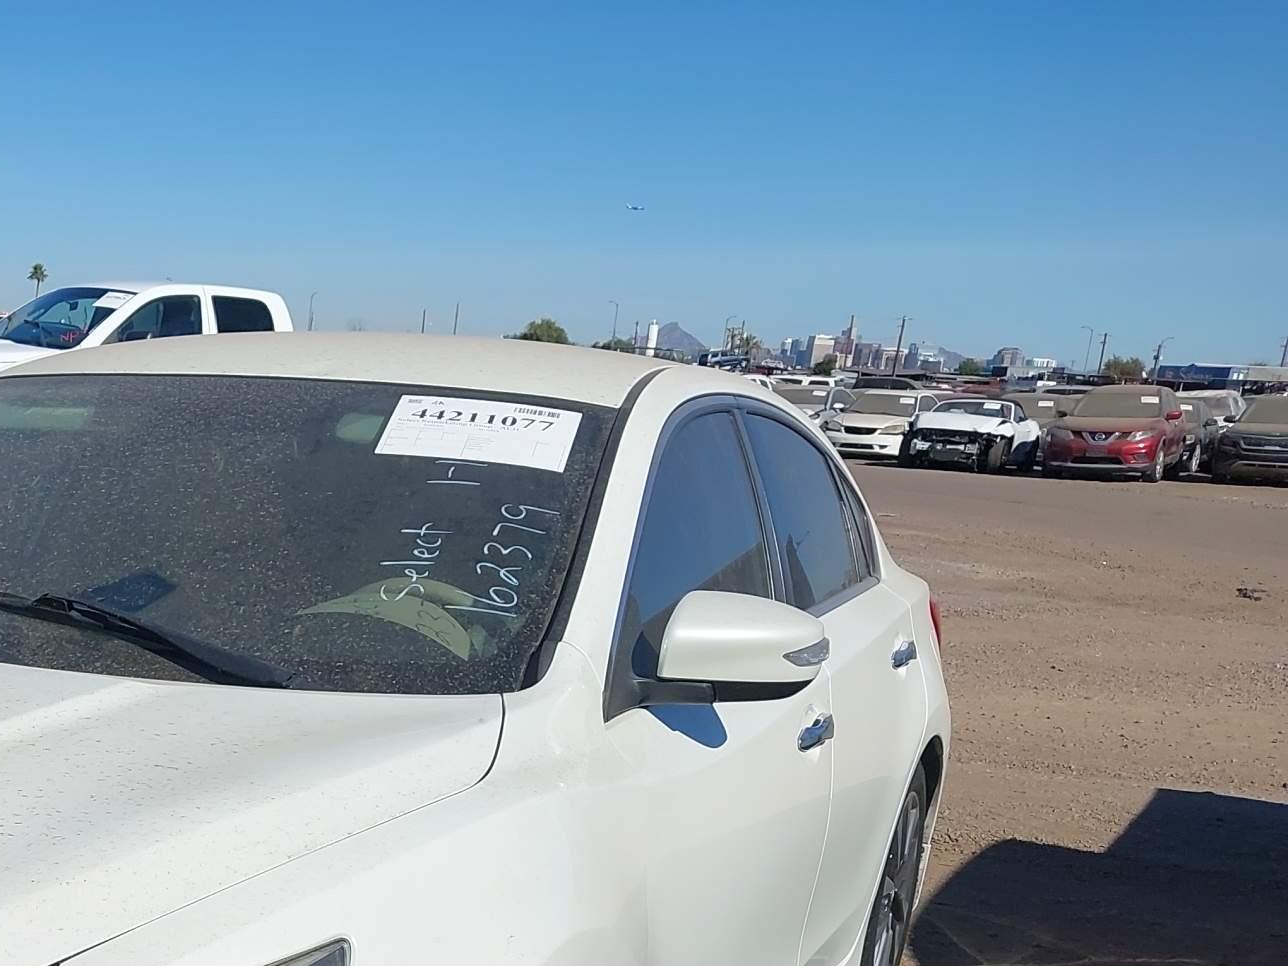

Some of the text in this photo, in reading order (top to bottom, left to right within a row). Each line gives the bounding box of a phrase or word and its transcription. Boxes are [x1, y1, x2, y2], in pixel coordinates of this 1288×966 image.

[411, 408, 554, 432] 44211077
[379, 522, 456, 602] Select
[443, 503, 561, 618] 162379
